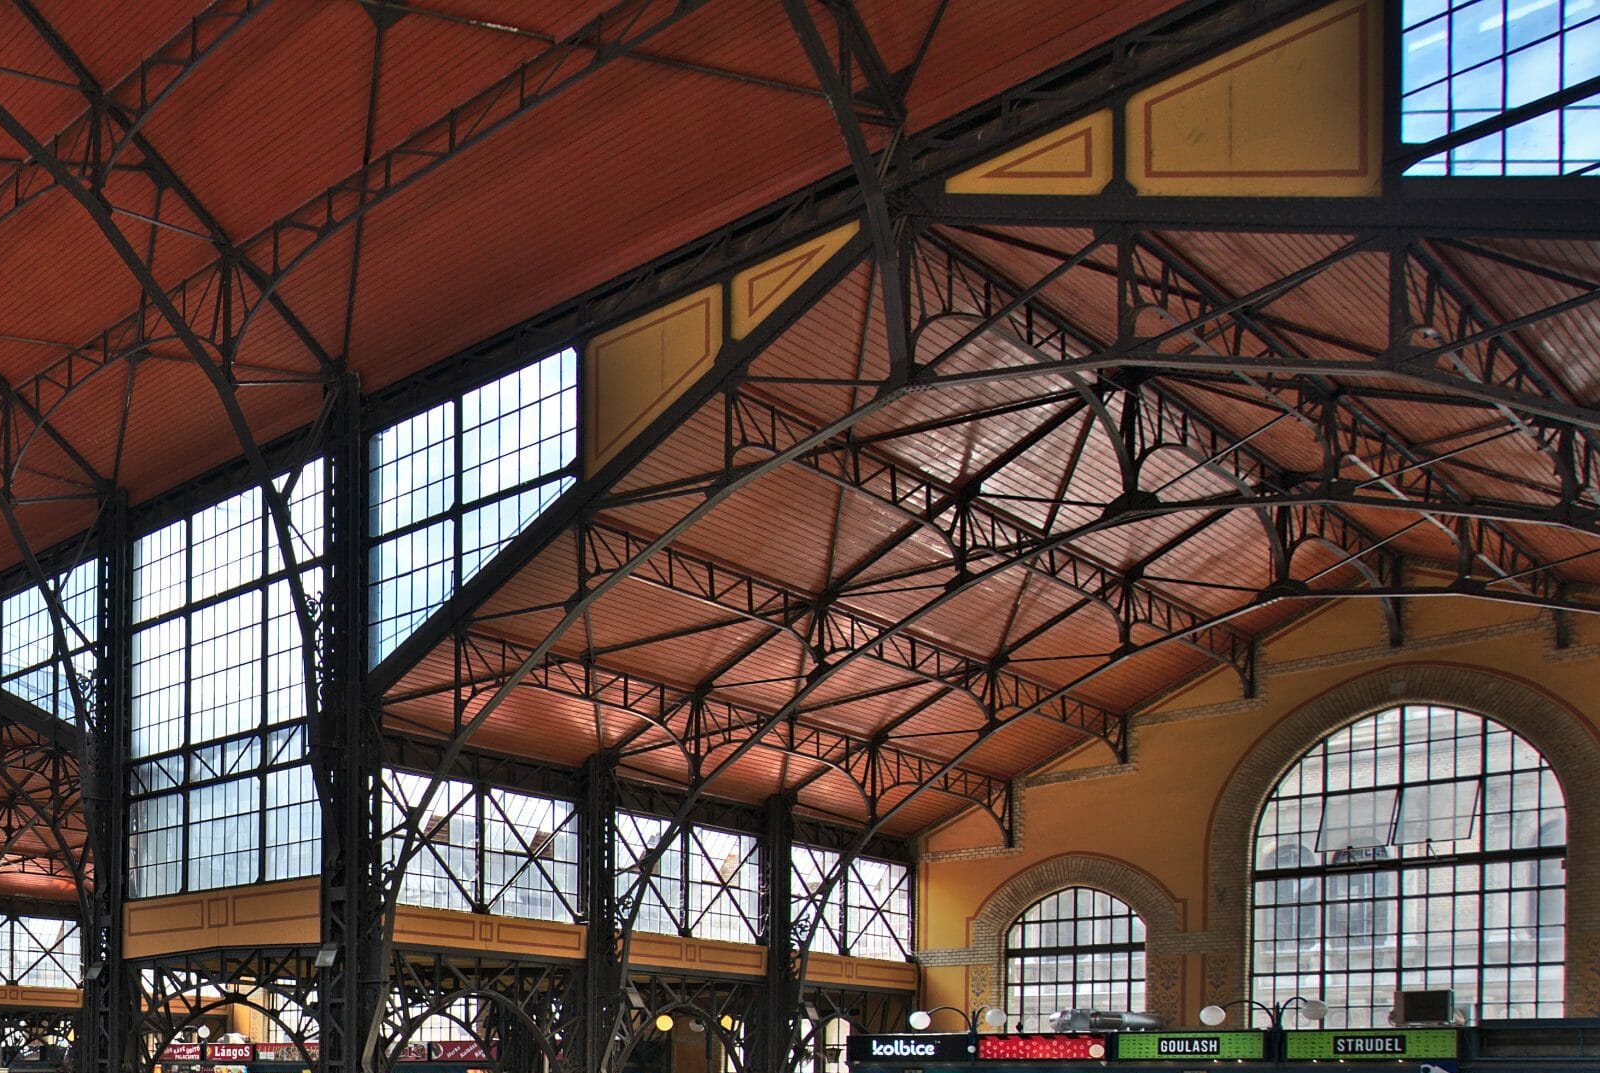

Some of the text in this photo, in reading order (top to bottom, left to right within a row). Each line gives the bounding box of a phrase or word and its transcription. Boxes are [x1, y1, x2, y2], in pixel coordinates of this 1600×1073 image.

[872, 1040, 935, 1056] kolbice
[1160, 1038, 1218, 1053] GOULASH
[1336, 1037, 1403, 1052] STRUDEL
[214, 1045, 250, 1060] LángoS
